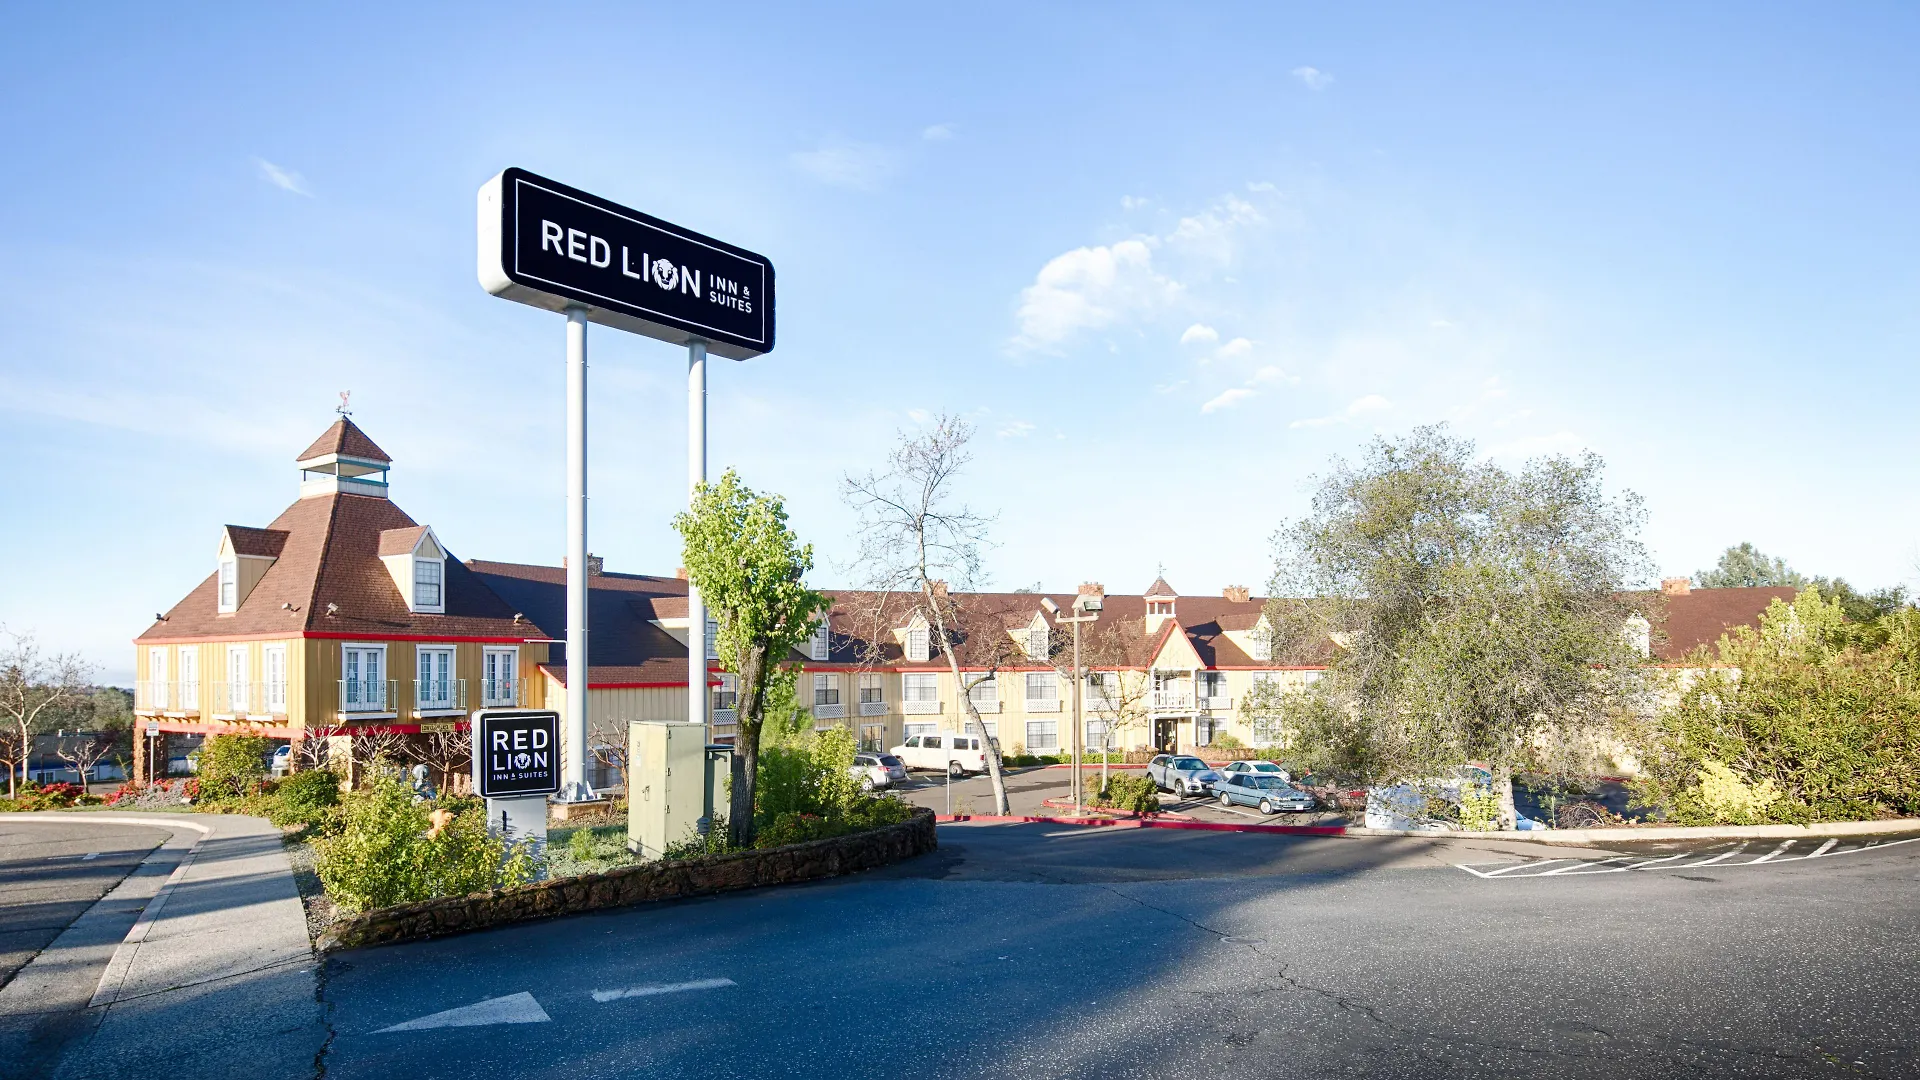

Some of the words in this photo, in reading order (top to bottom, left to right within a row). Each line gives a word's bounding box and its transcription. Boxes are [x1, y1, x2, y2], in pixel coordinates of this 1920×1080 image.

[541, 219, 611, 268] RED
[622, 246, 701, 298] LION
[710, 273, 738, 296] INN
[743, 285, 750, 299] &
[709, 290, 752, 314] SUITES
[493, 729, 548, 752] RED
[493, 751, 548, 771] LION
[518, 771, 548, 779] SUITES
